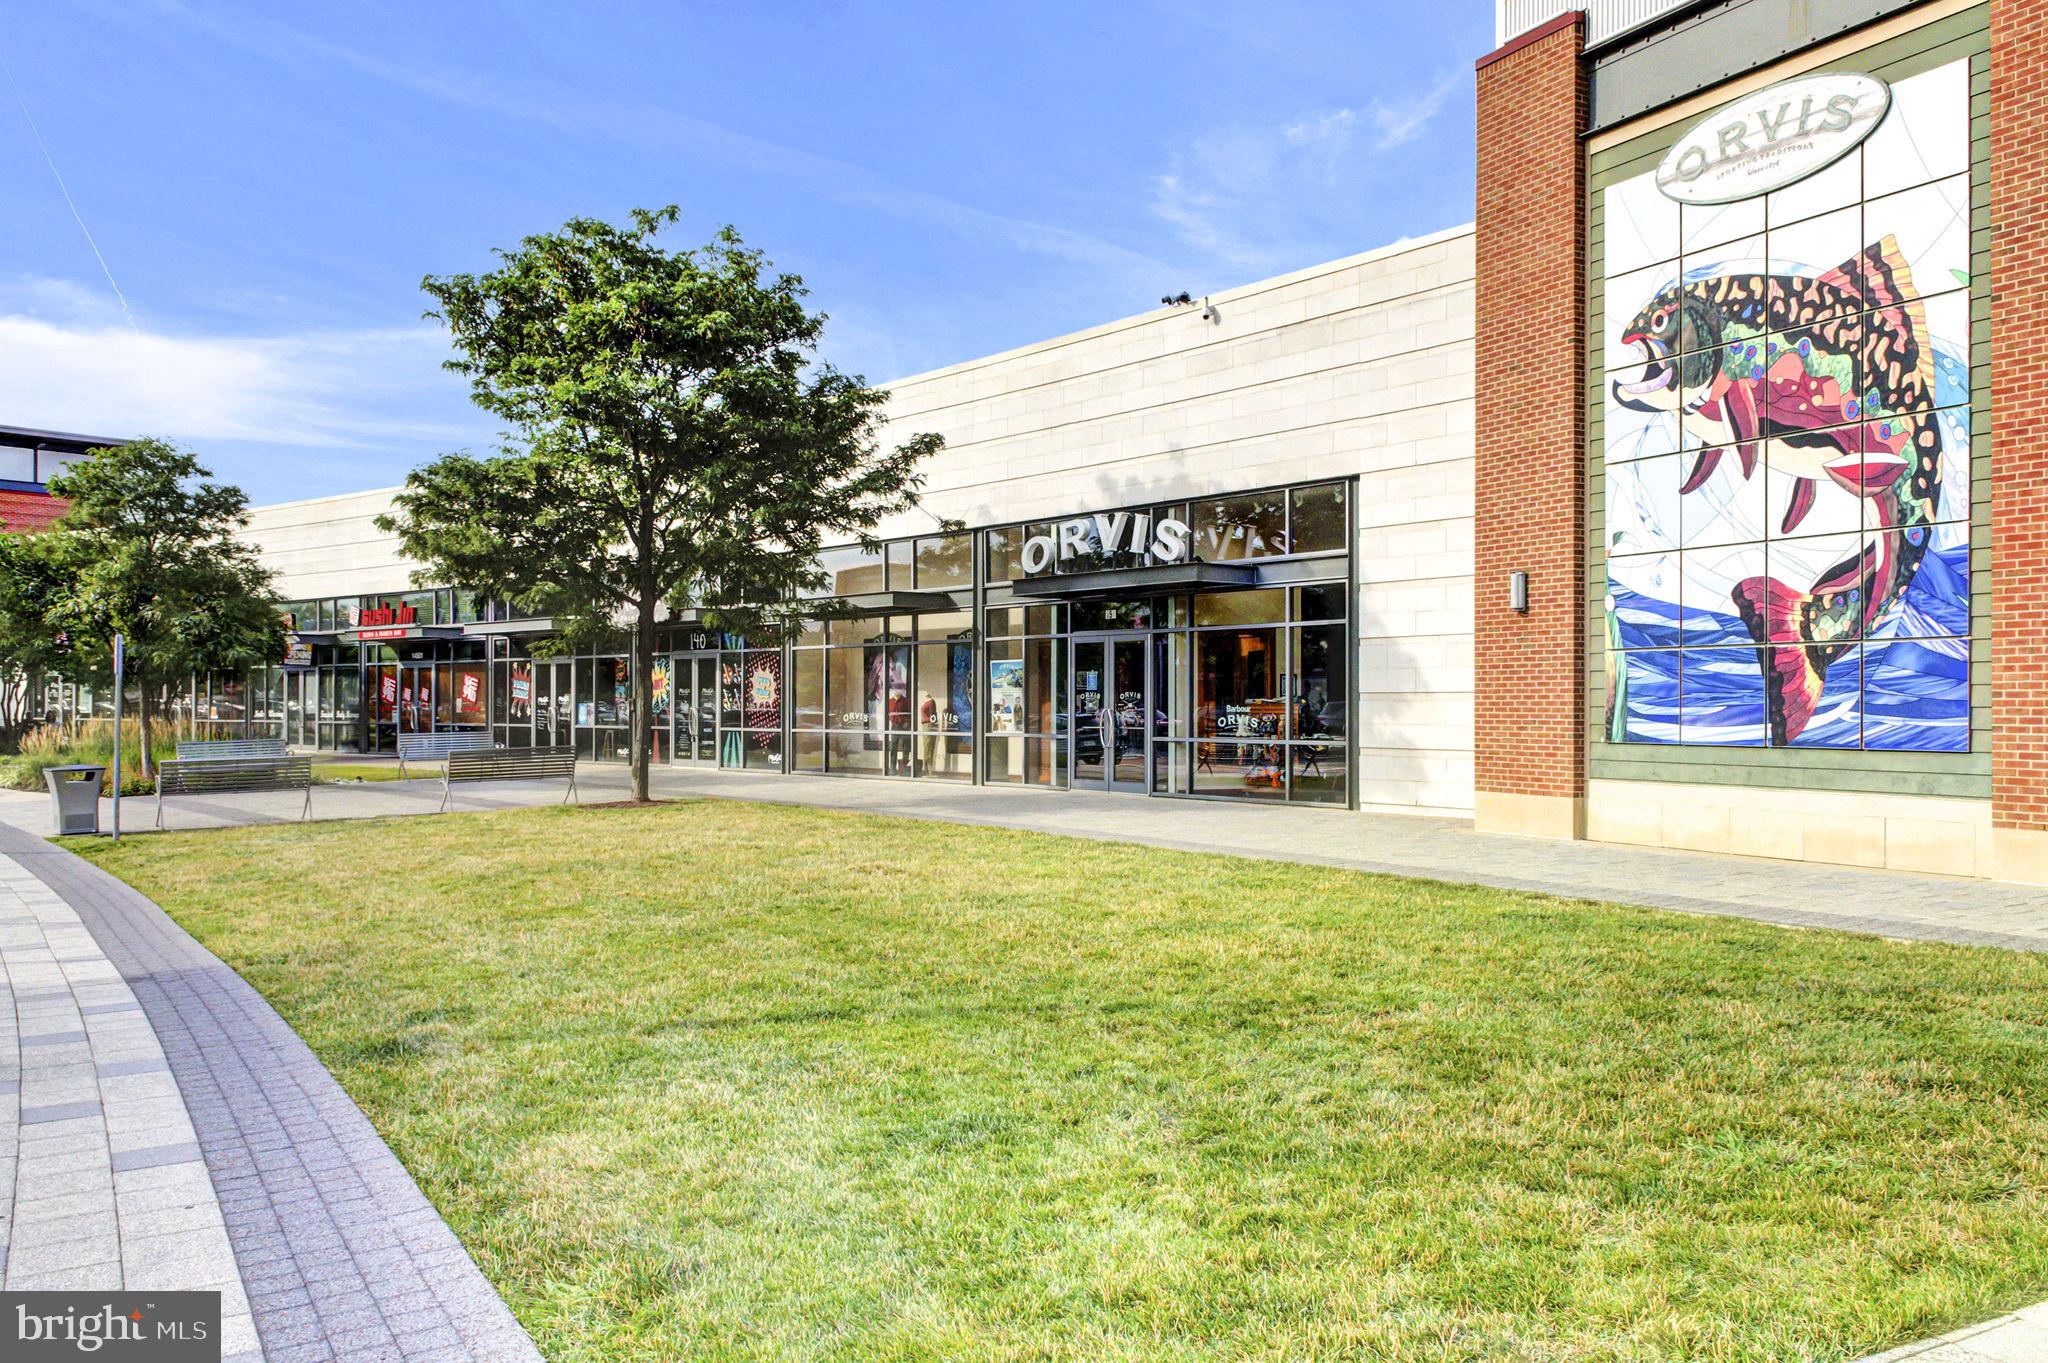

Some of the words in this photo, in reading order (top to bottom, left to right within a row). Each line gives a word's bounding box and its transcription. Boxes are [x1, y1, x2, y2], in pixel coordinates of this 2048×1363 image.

[1675, 94, 1858, 182] ORVIS
[1715, 157, 1758, 181] SPORTING
[1021, 512, 1192, 574] ORVIS
[690, 633, 706, 650] 140
[1080, 692, 1101, 700] ORVIS
[1119, 692, 1142, 700] ORVIS
[1226, 704, 1251, 713] Barbour
[843, 711, 869, 723] ORVIS
[1217, 714, 1259, 728] ORVIS
